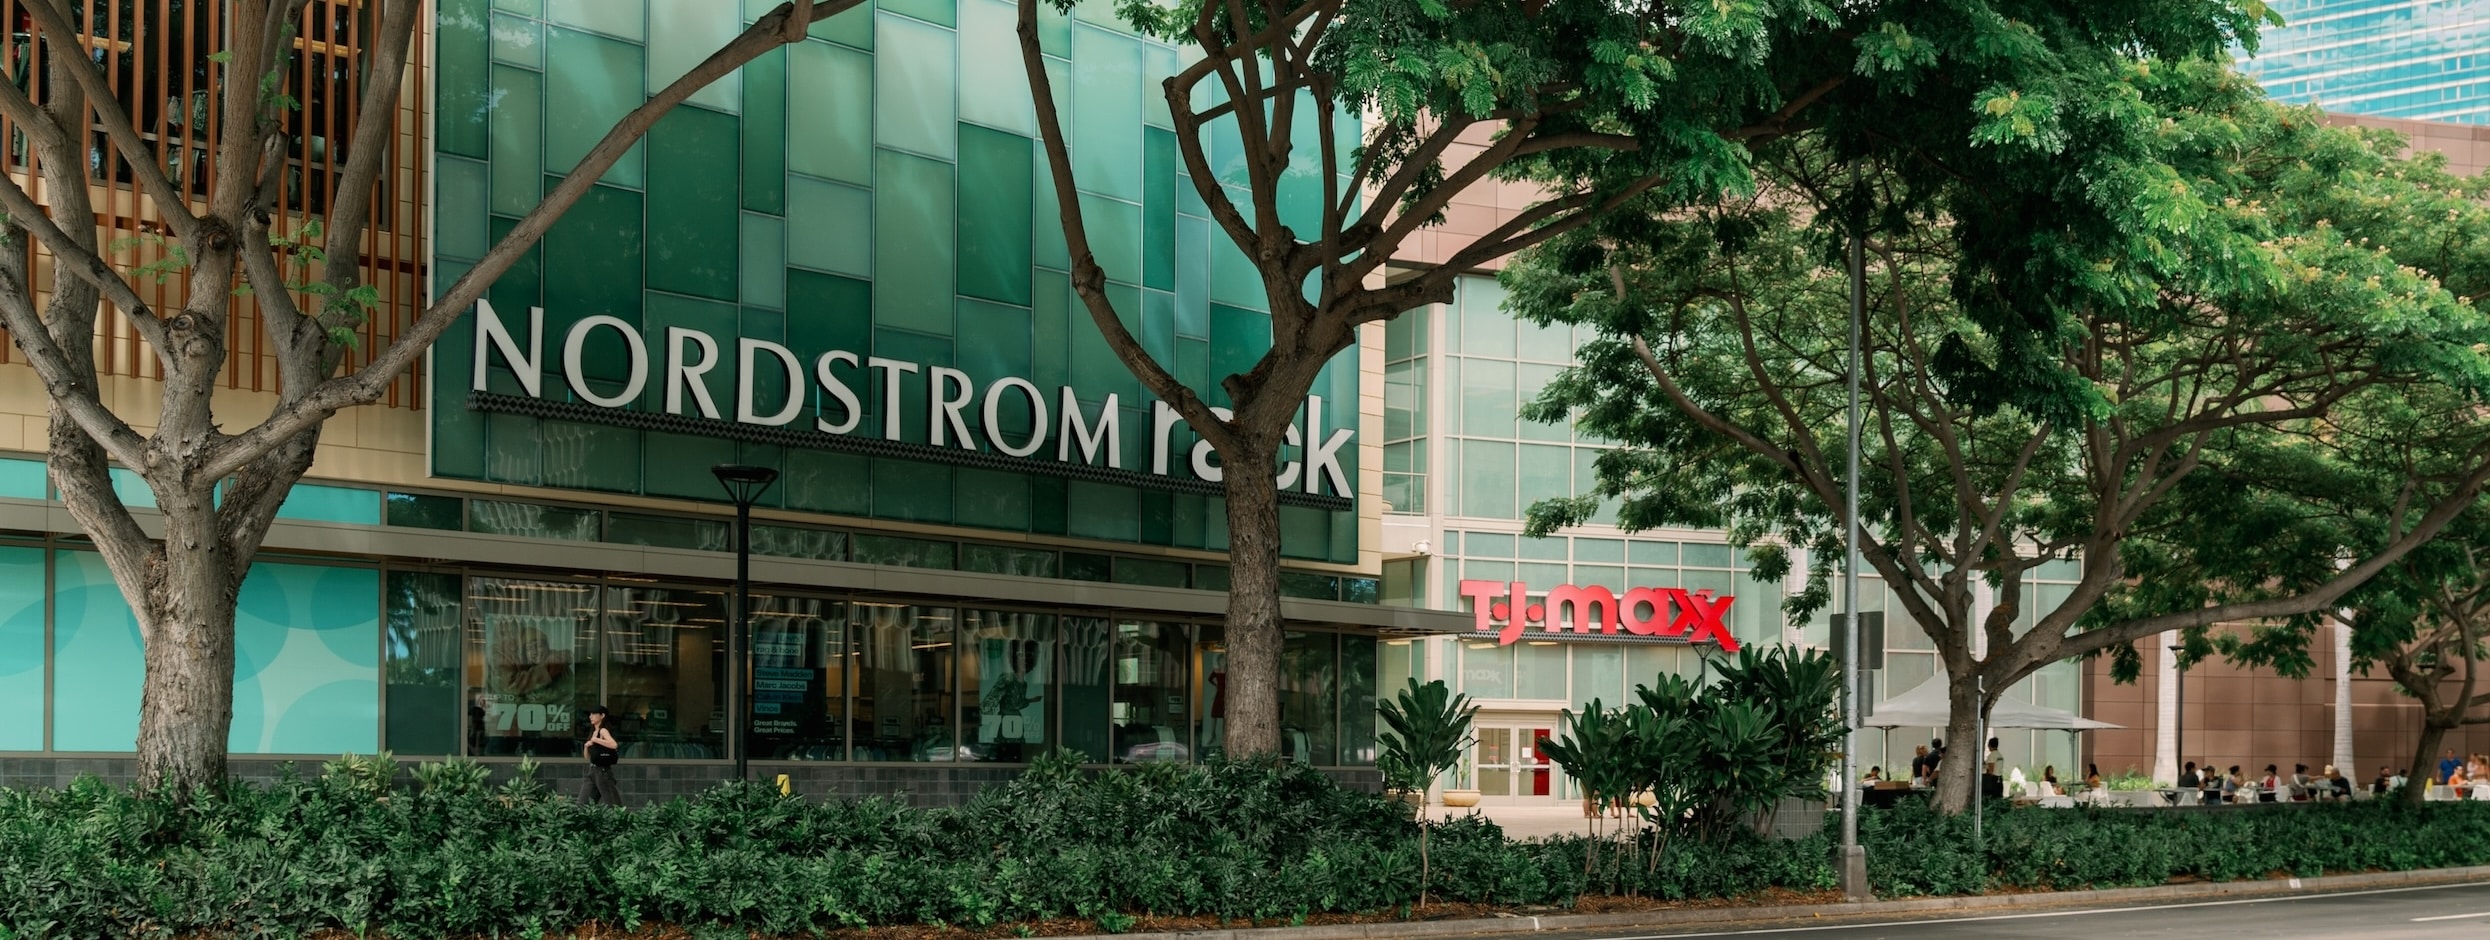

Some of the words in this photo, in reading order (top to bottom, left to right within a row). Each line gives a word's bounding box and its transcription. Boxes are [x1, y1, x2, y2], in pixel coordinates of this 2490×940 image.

[473, 298, 1120, 468] NORDSTROM
[756, 669, 779, 677] Steve
[780, 670, 812, 678] Madden
[778, 682, 805, 690] Jacobs
[547, 723, 571, 731] OFF
